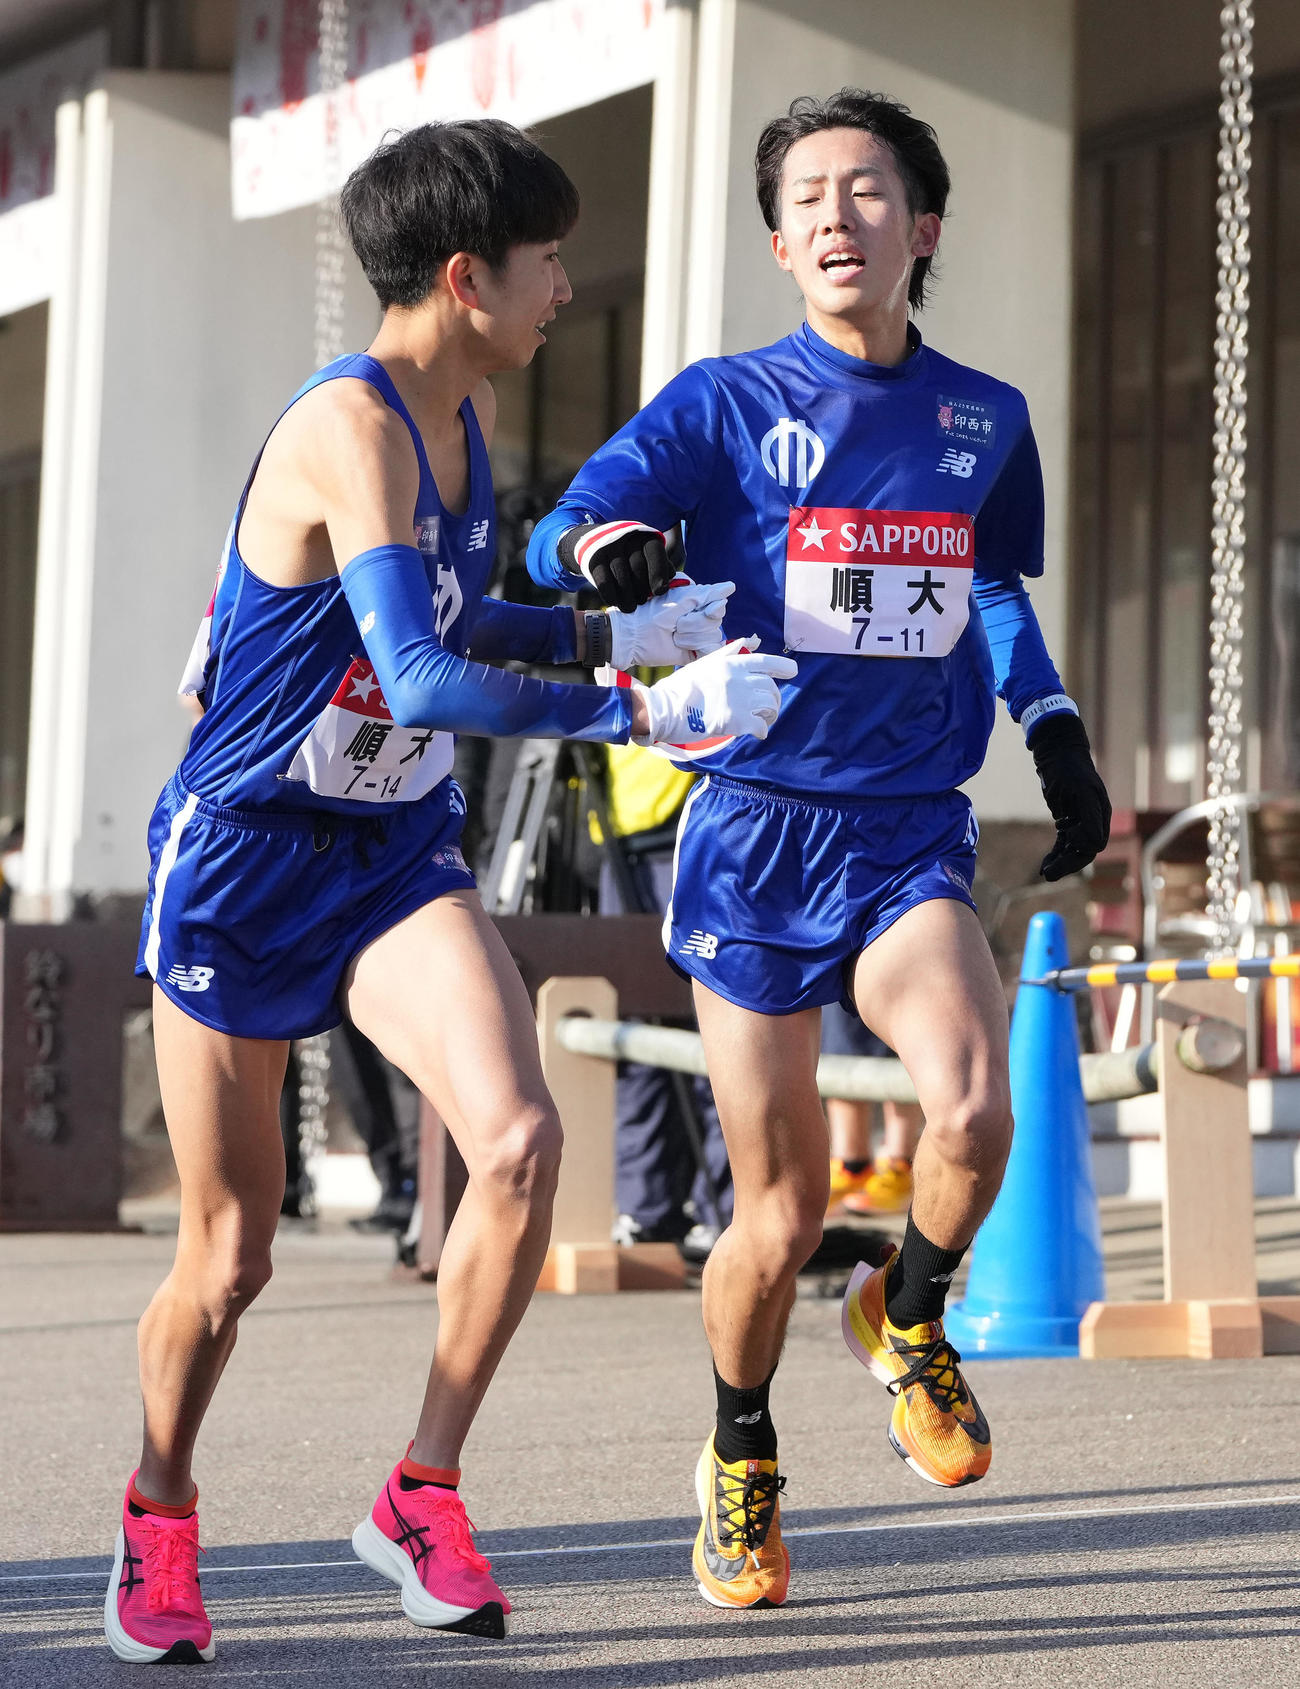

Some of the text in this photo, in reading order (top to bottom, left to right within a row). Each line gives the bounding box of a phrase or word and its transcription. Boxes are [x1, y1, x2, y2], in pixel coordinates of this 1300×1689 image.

[954, 413, 993, 435] 印西市
[839, 522, 969, 557] SAPPORO
[852, 617, 924, 652] 7-11
[344, 765, 403, 798] 7-14
